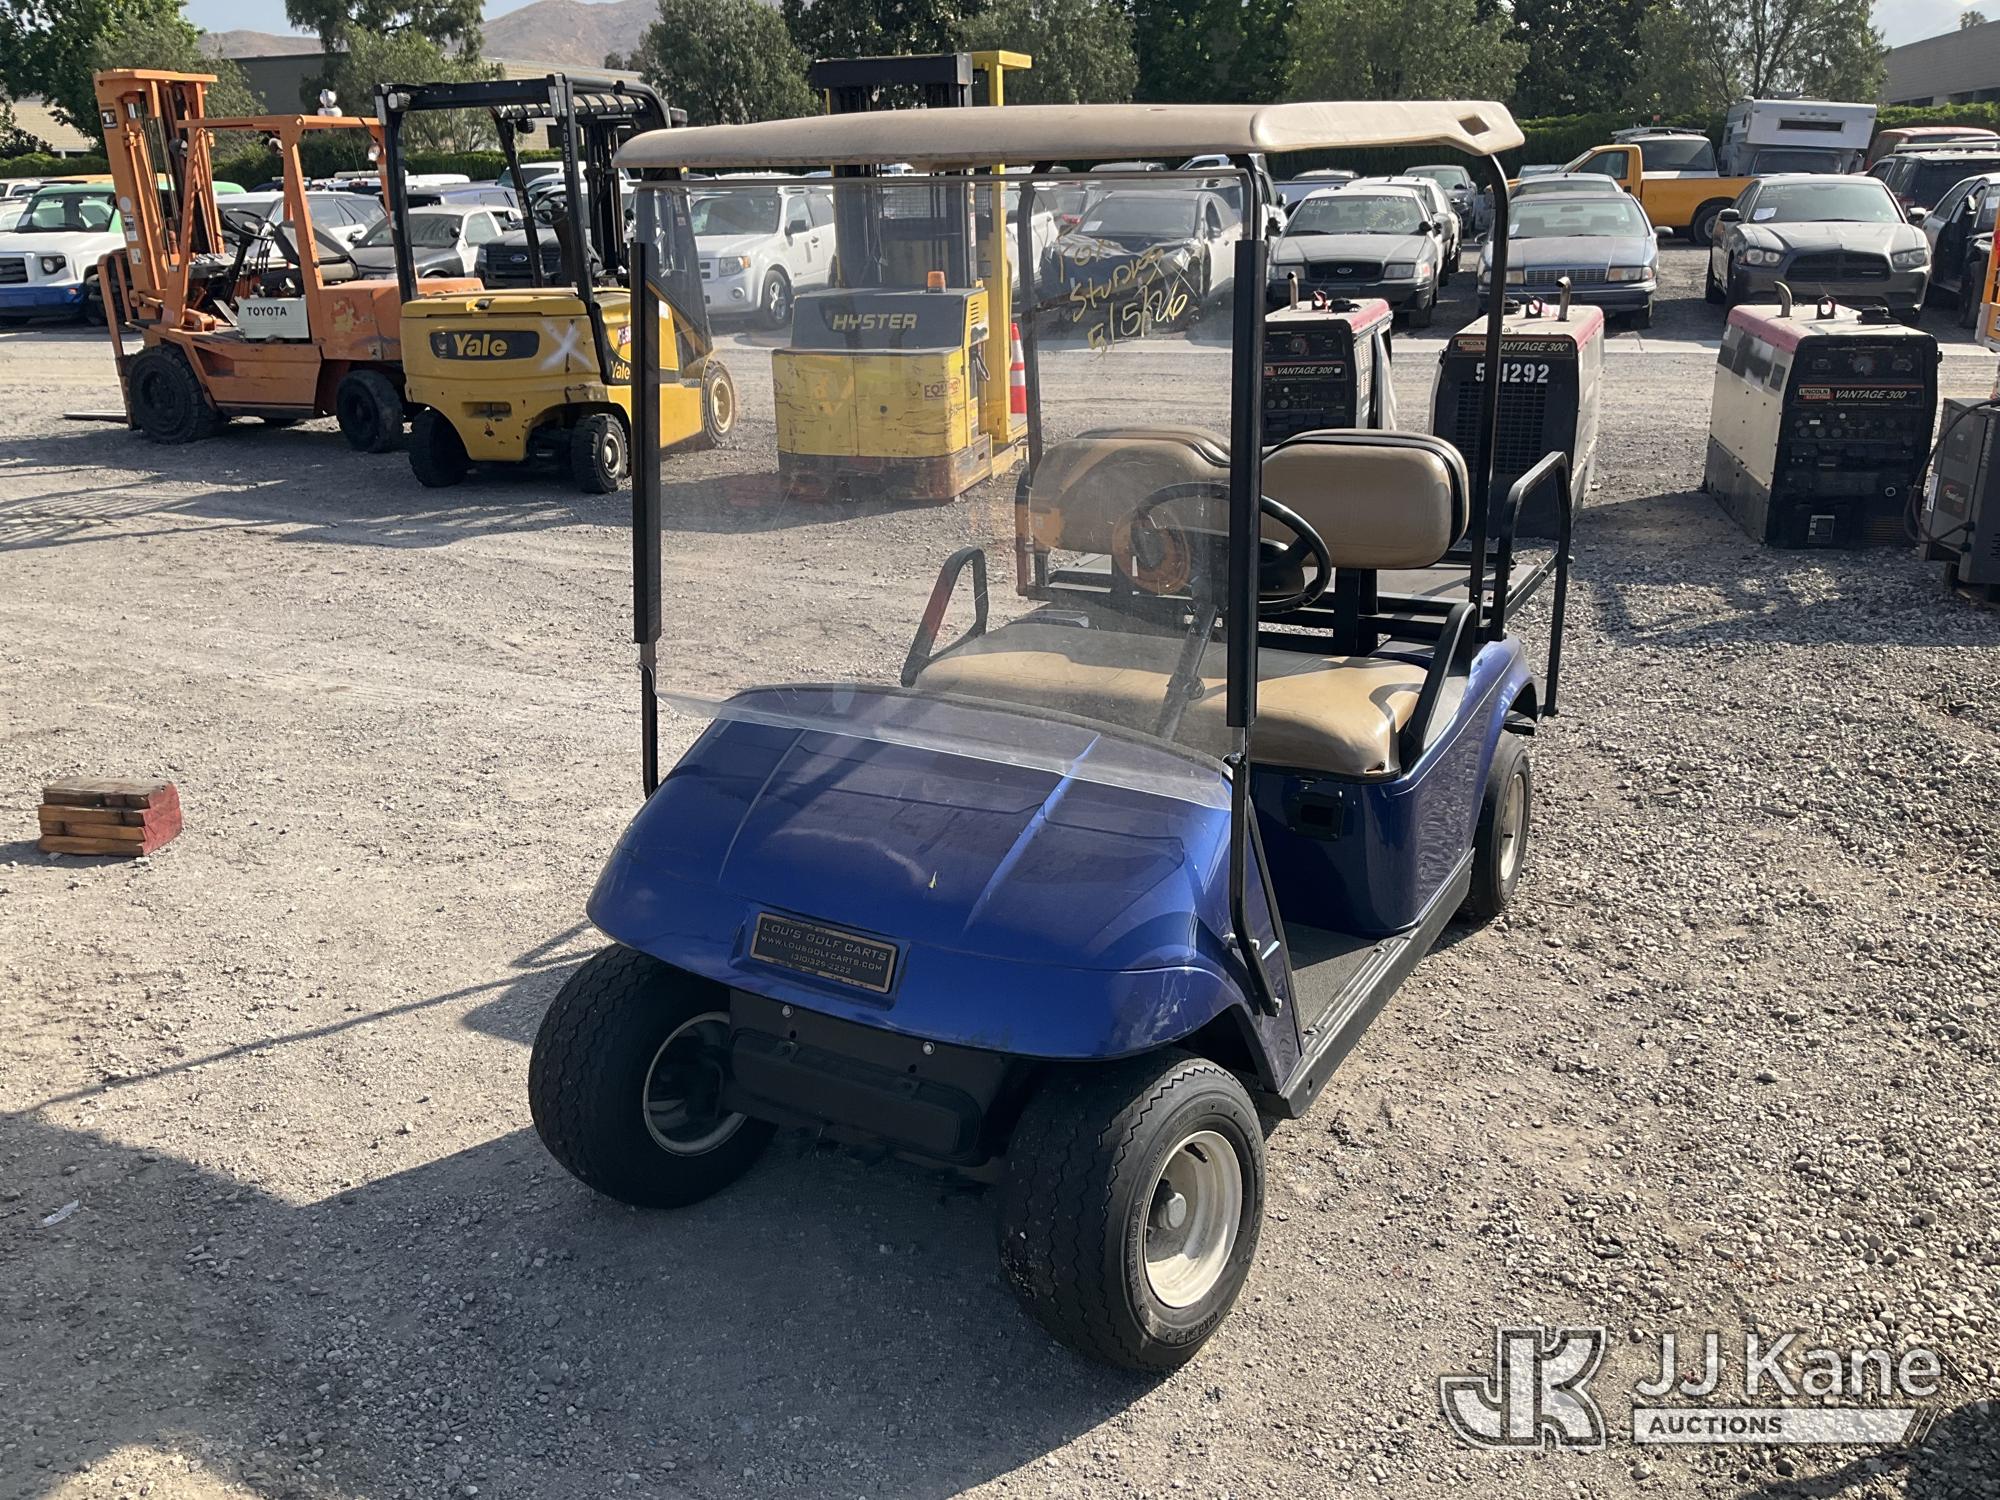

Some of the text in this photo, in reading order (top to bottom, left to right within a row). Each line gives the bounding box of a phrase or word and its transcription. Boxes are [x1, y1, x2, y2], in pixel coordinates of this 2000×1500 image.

[246, 306, 287, 317] TOYOTA
[832, 313, 918, 330] HYSTER
[453, 333, 508, 356] Yale
[1547, 342, 1568, 352] 300
[611, 361, 631, 380] Yale
[1277, 367, 1317, 375] VANTAGE
[1318, 366, 1334, 374] 300
[1475, 362, 1550, 383] 51292
[1835, 390, 1907, 399] VANTAGE 300
[763, 922, 888, 961] LOU'S GOLF CARTS
